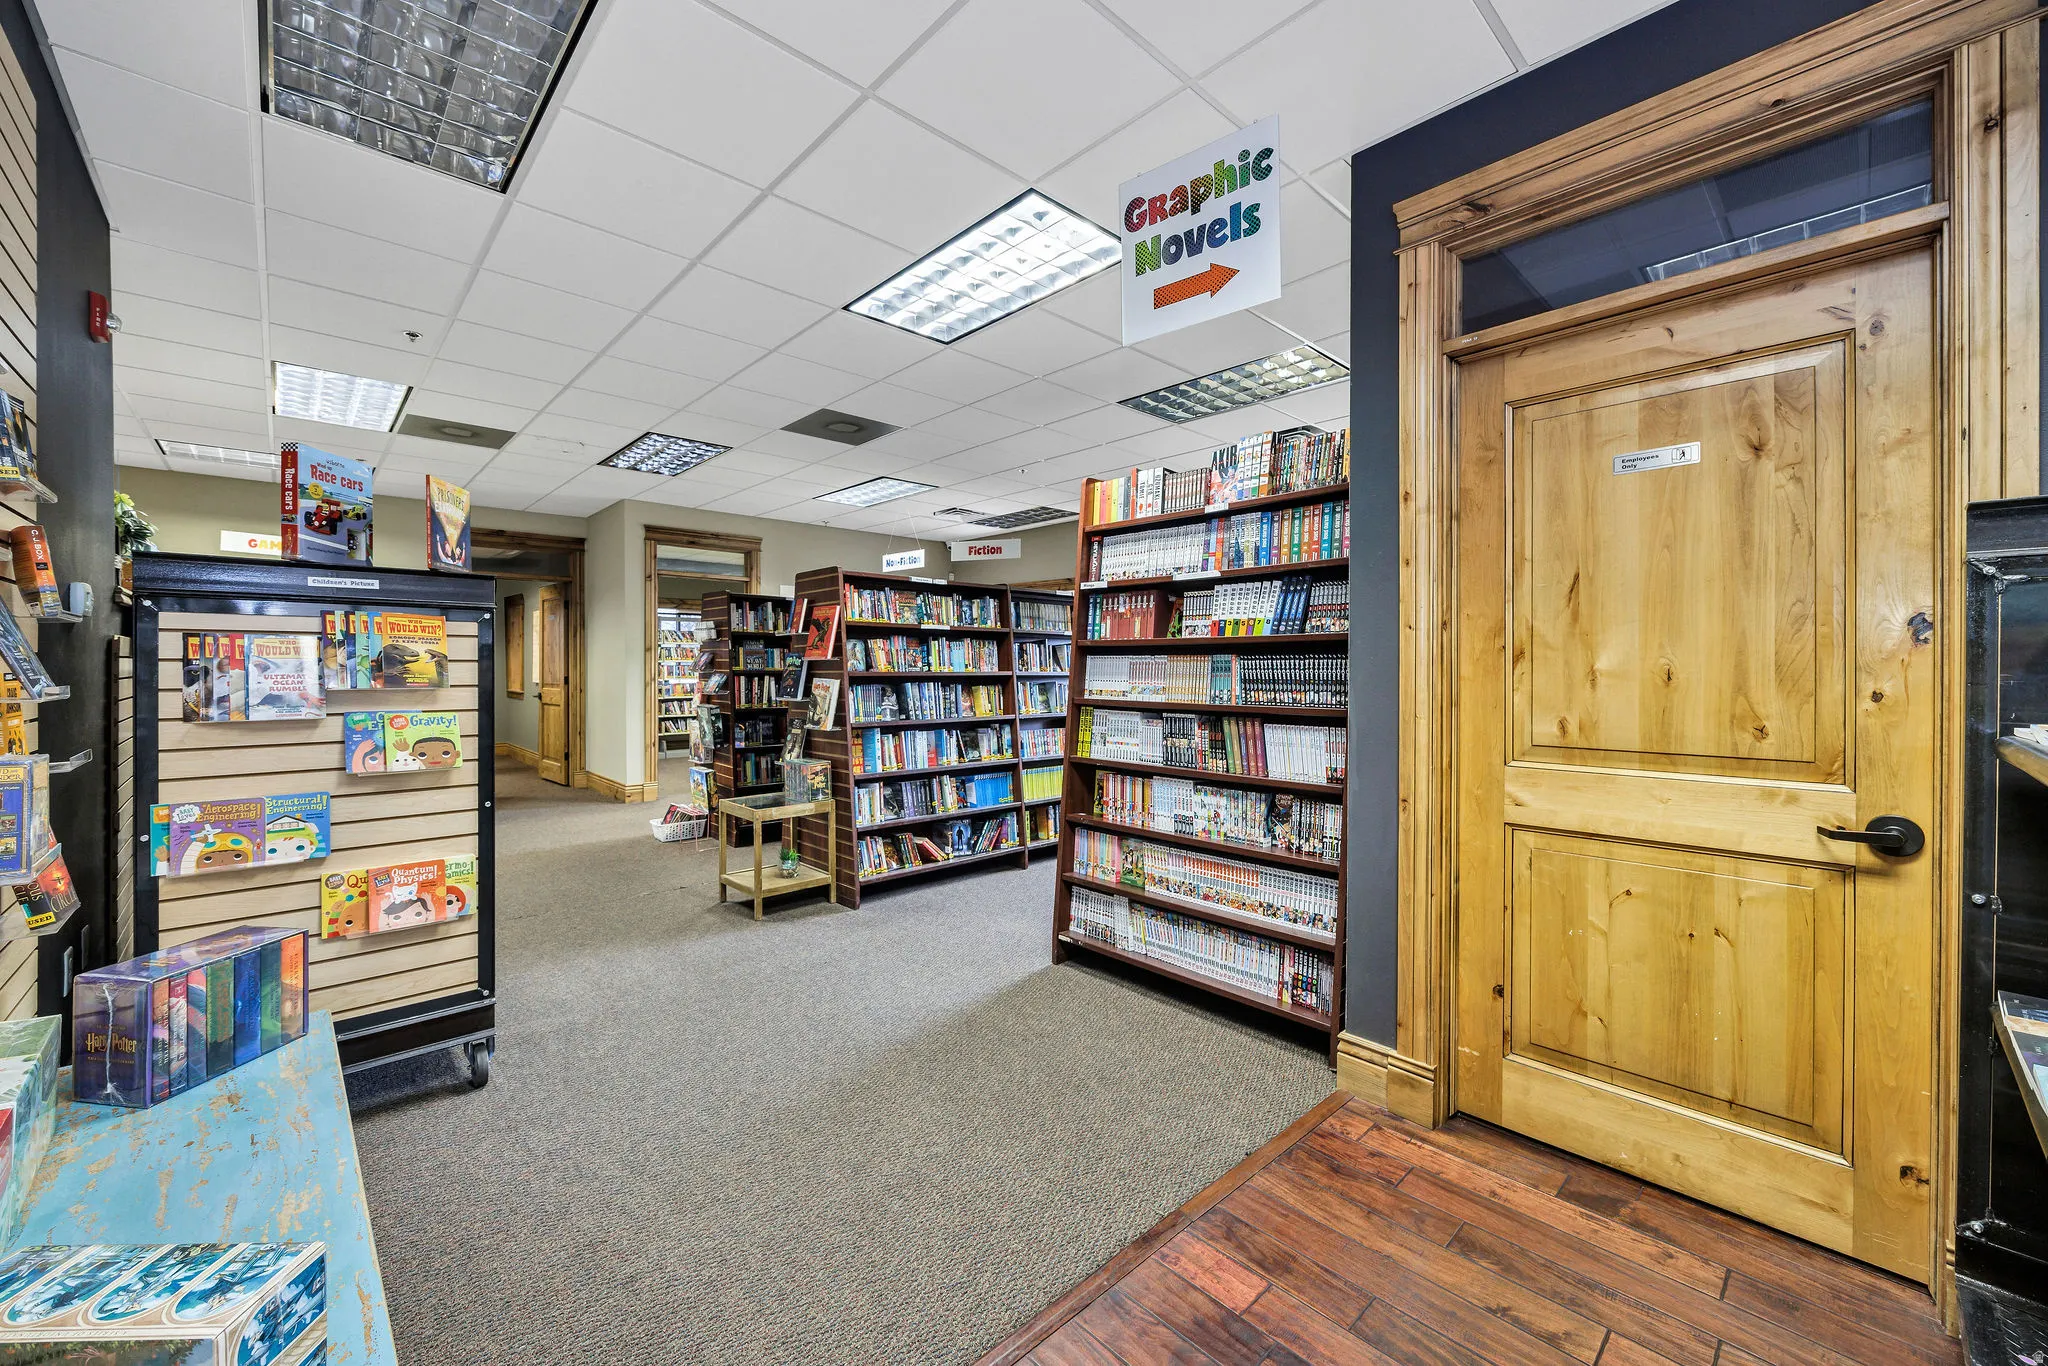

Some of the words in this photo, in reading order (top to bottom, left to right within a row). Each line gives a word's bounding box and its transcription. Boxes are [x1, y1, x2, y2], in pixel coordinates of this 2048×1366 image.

[1124, 147, 1274, 233] Graphic
[1135, 201, 1261, 277] Novels
[1621, 454, 1660, 464] Employees
[284, 467, 295, 489] Race
[310, 464, 337, 485] Race
[340, 476, 364, 492] cars
[284, 491, 293, 511] cars
[968, 546, 1003, 556] Fiction
[388, 621, 418, 634] WOULD
[420, 624, 442, 635] WIN?
[255, 643, 291, 657] WOULD
[410, 714, 457, 728] Gravity!
[266, 794, 322, 807] Structural
[266, 795, 328, 814] Engineering!
[196, 803, 262, 823] Engineering!
[206, 803, 257, 815] Aerospace
[391, 866, 434, 877] Quantum
[394, 865, 438, 885] Physics!
[28, 915, 52, 925] USED
[85, 1032, 109, 1053] Harry
[112, 1032, 137, 1053] Potter
